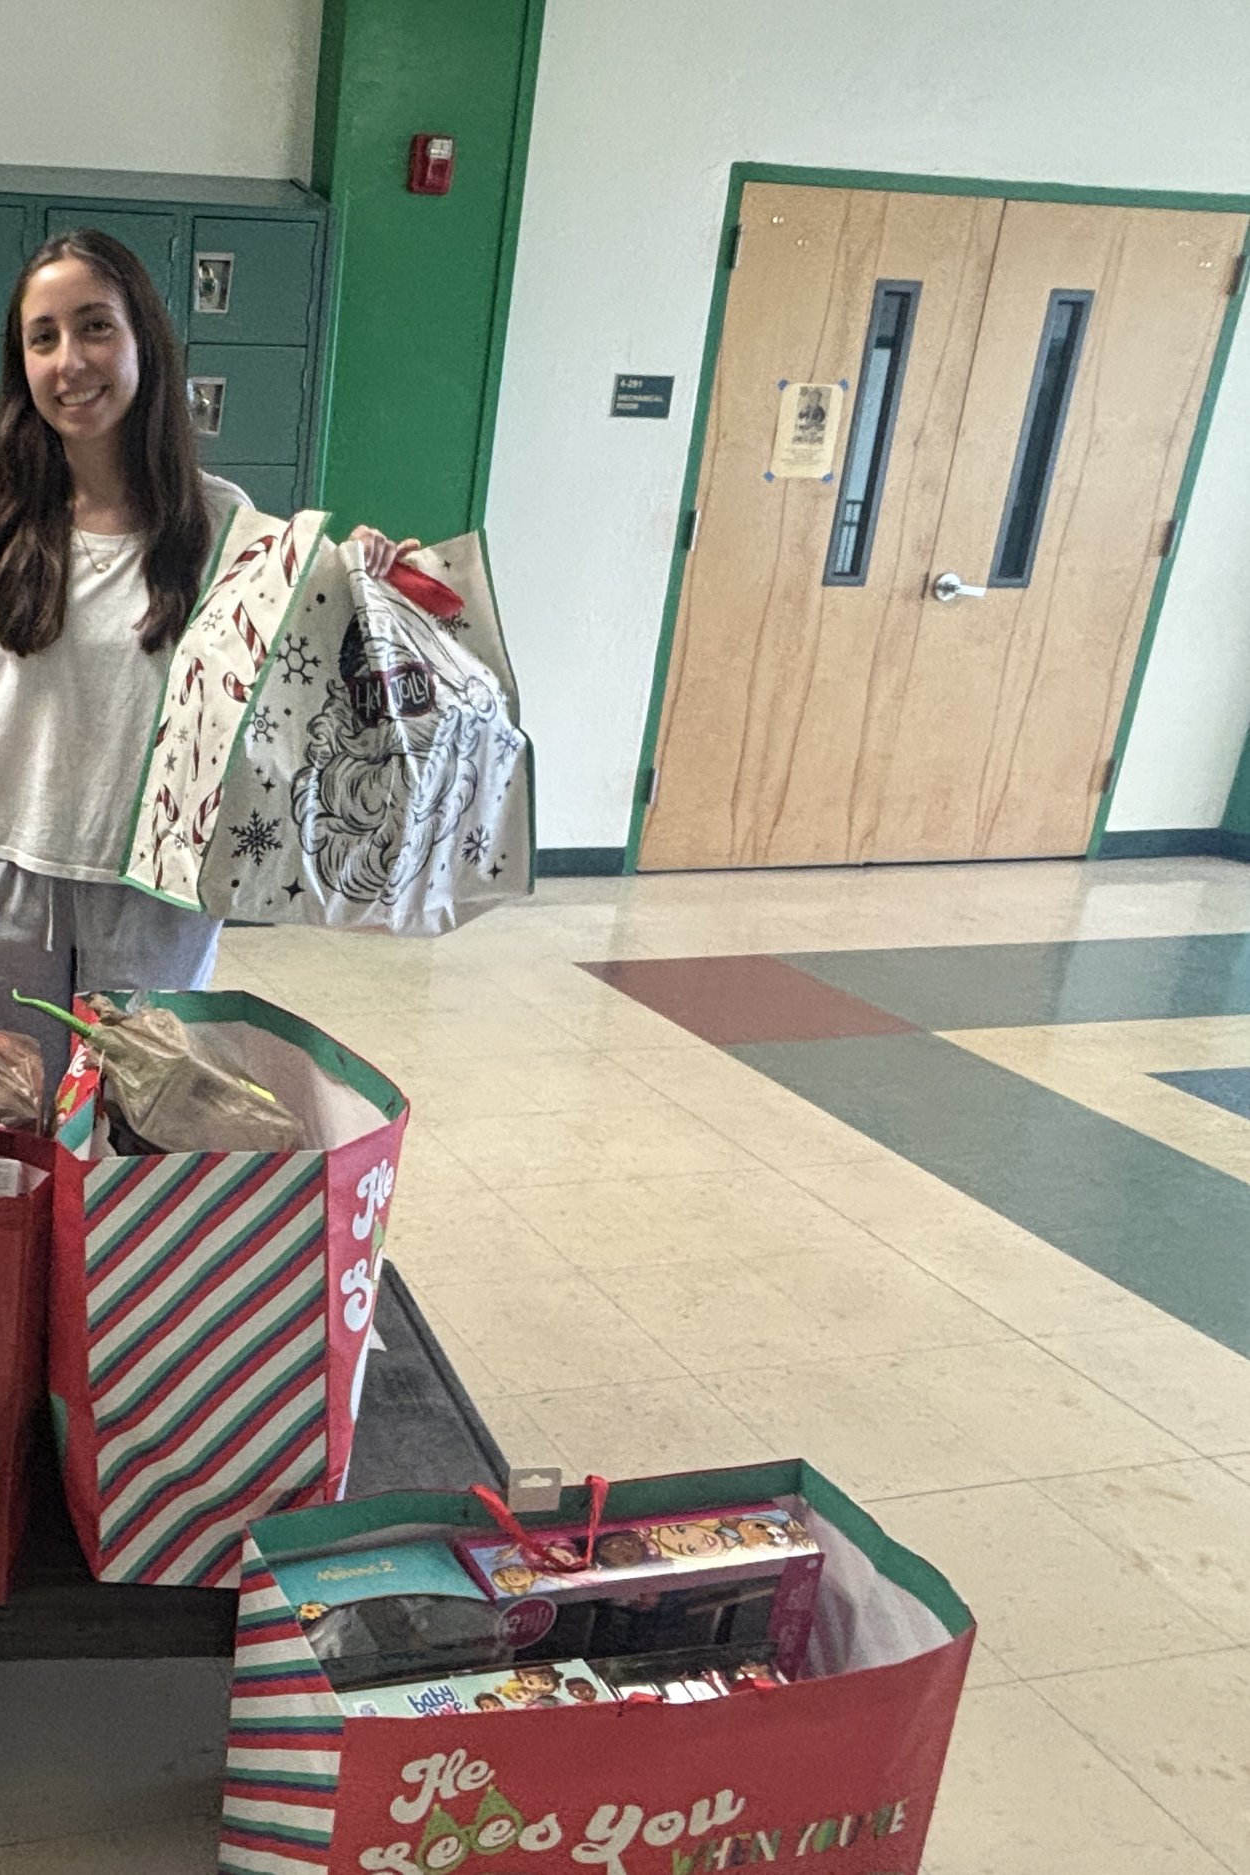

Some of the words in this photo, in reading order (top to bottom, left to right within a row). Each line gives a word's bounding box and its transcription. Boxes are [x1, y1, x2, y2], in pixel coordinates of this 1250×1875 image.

[390, 671, 431, 710] JOLLY
[352, 1158, 394, 1240] He
[407, 1684, 456, 1714] baby
[390, 1748, 495, 1824] He
[570, 1789, 747, 1875] You
